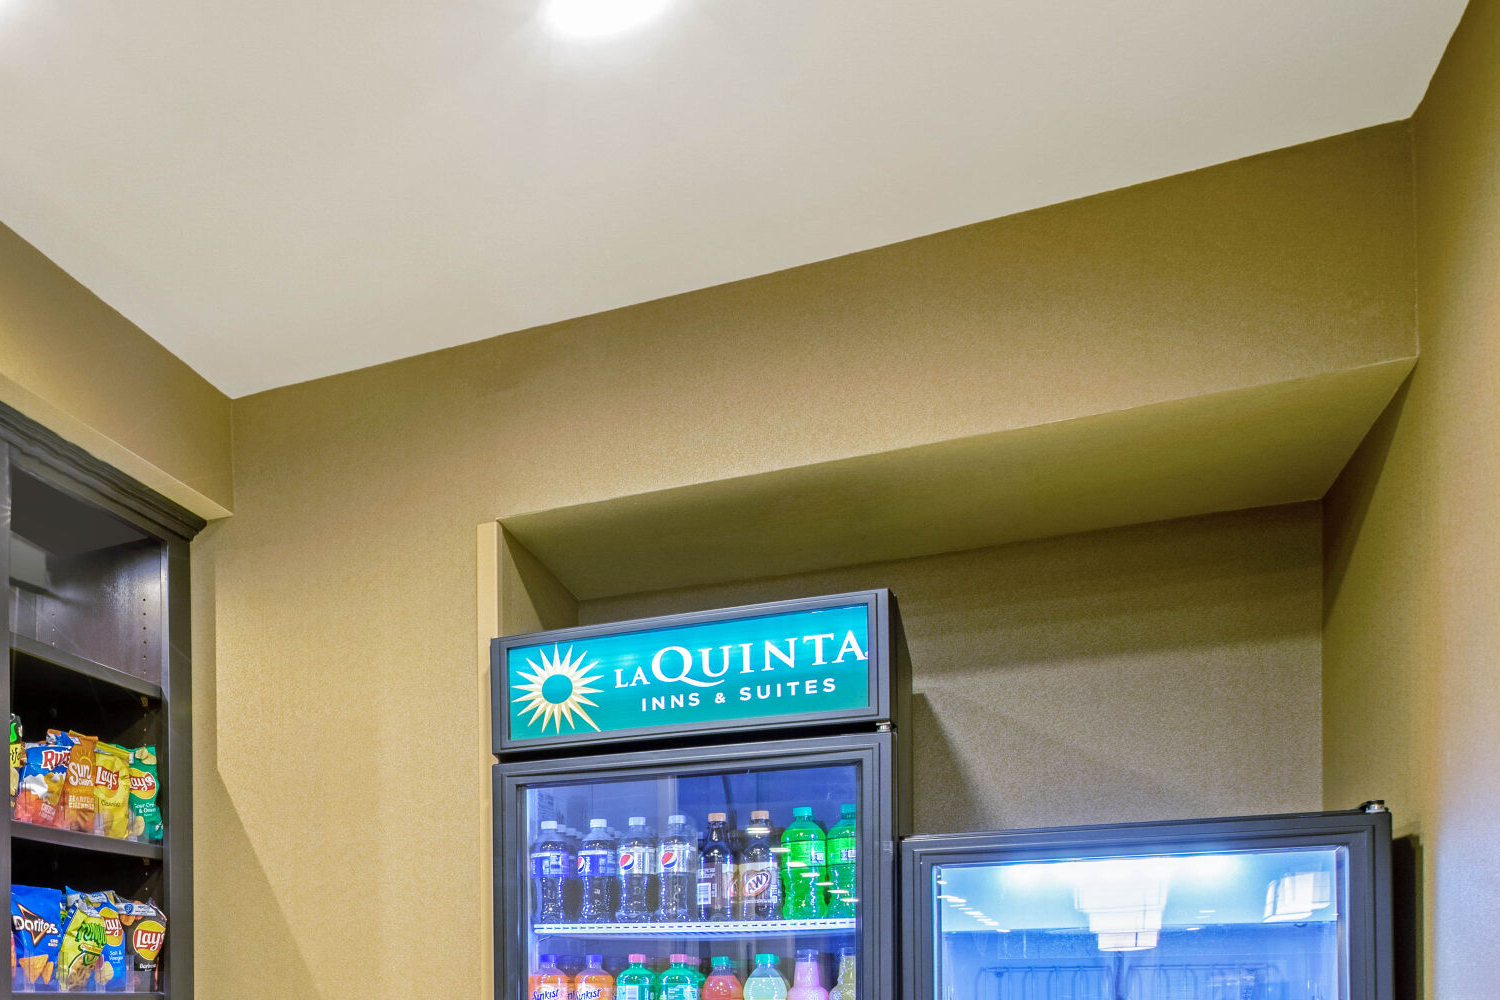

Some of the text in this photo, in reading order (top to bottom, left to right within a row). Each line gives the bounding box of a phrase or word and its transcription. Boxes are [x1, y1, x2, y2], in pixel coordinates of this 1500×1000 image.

[614, 629, 869, 689] LA QUINTA
[641, 677, 837, 712] INNS & SUITES
[69, 762, 92, 786] Sun
[95, 766, 119, 790] Lay's
[12, 916, 59, 935] Doritos
[136, 930, 165, 952] Lay's
